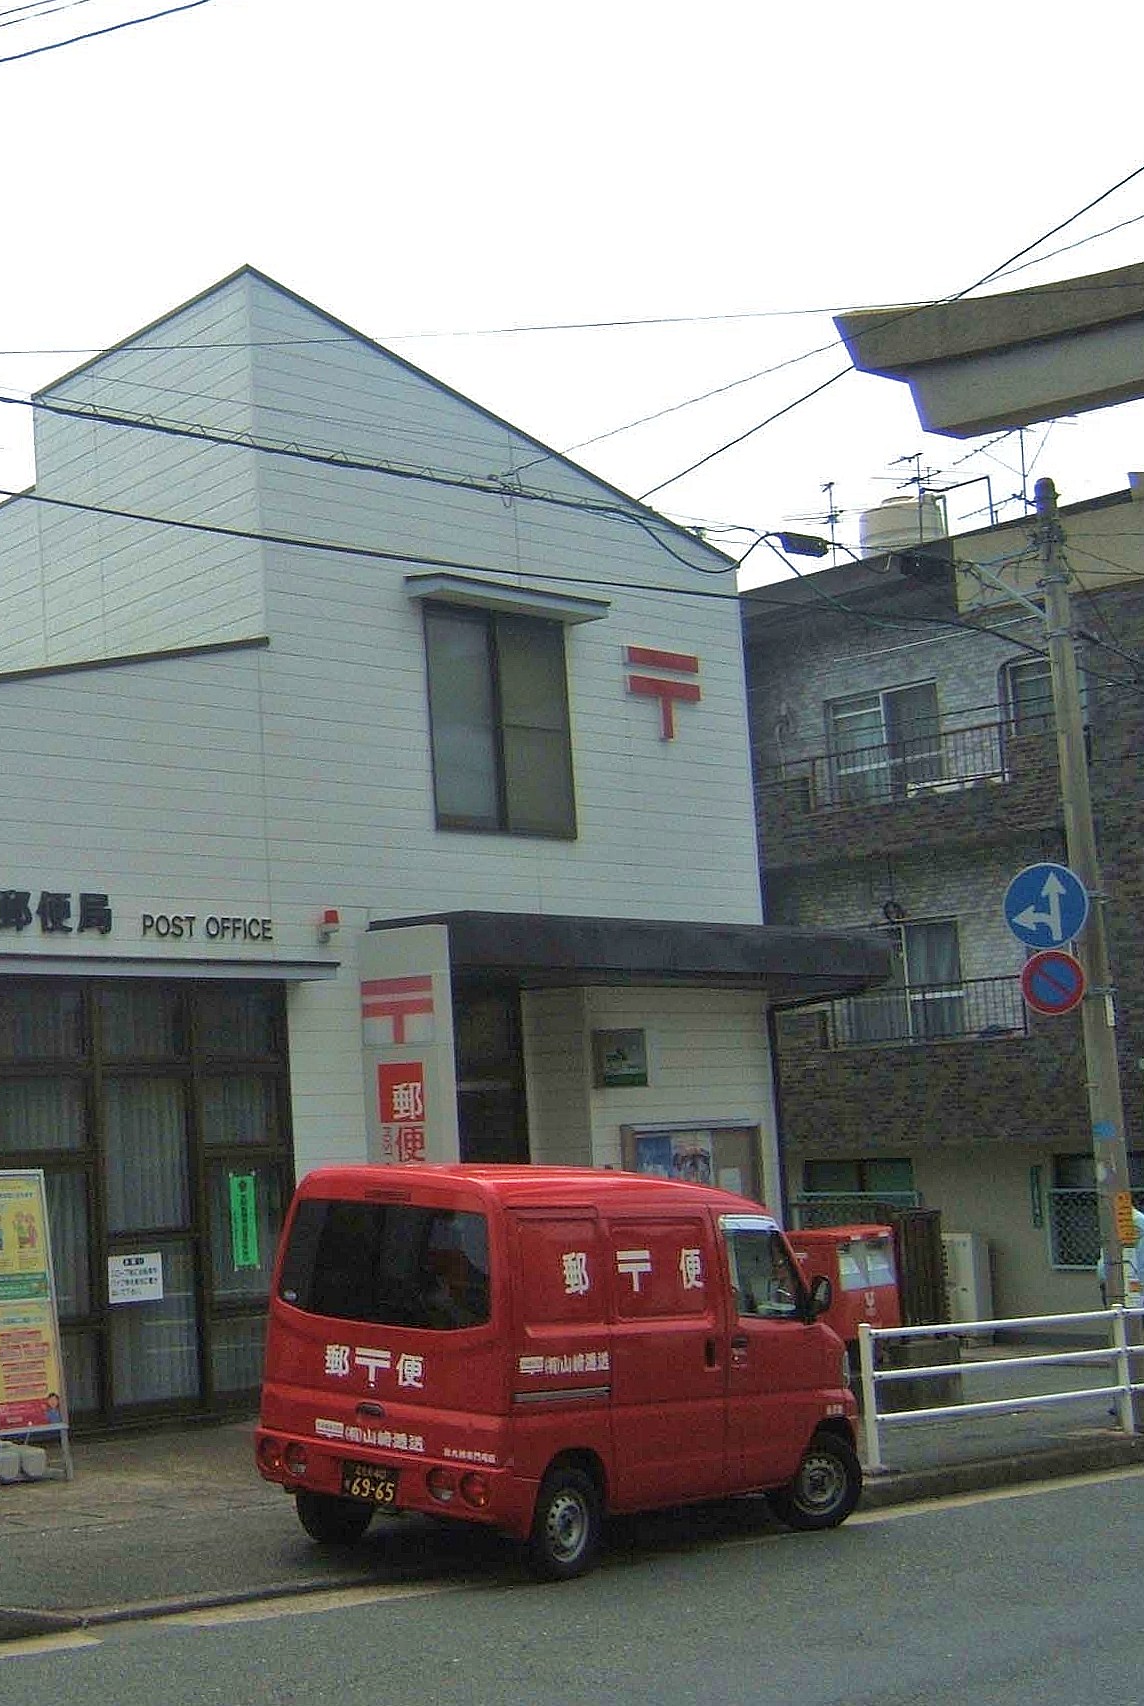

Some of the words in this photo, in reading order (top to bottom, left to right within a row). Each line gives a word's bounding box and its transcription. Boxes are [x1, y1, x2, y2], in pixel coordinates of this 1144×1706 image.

[141, 914, 196, 938] POST
[206, 916, 274, 941] OFFICE
[392, 1081, 426, 1162] 郵便
[350, 1476, 396, 1503] 69-65
